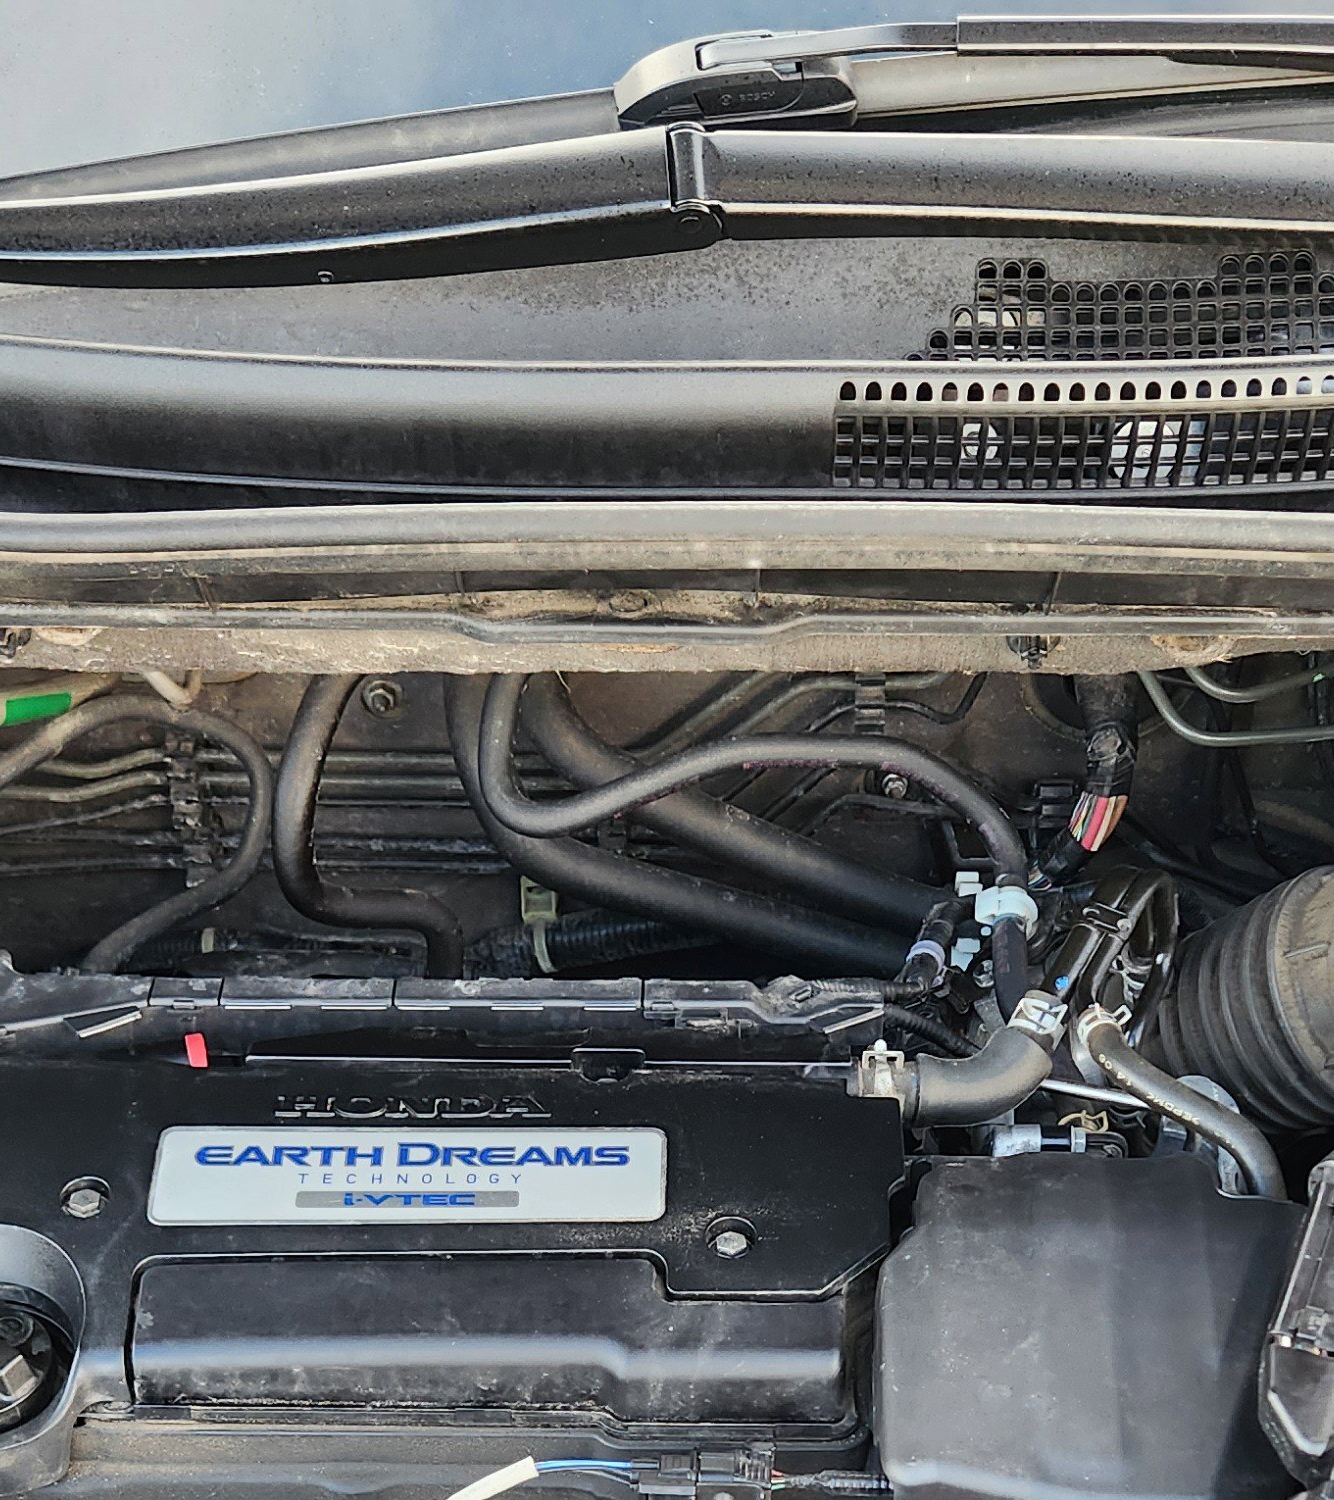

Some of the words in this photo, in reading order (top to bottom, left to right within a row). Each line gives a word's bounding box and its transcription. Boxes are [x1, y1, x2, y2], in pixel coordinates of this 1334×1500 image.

[274, 1094, 552, 1119] HONDA
[194, 1142, 385, 1168] EARTH
[396, 1140, 631, 1168] DREAMS
[297, 1172, 524, 1185] TECHNOLOGY
[343, 1191, 476, 1207] i-VTEC
